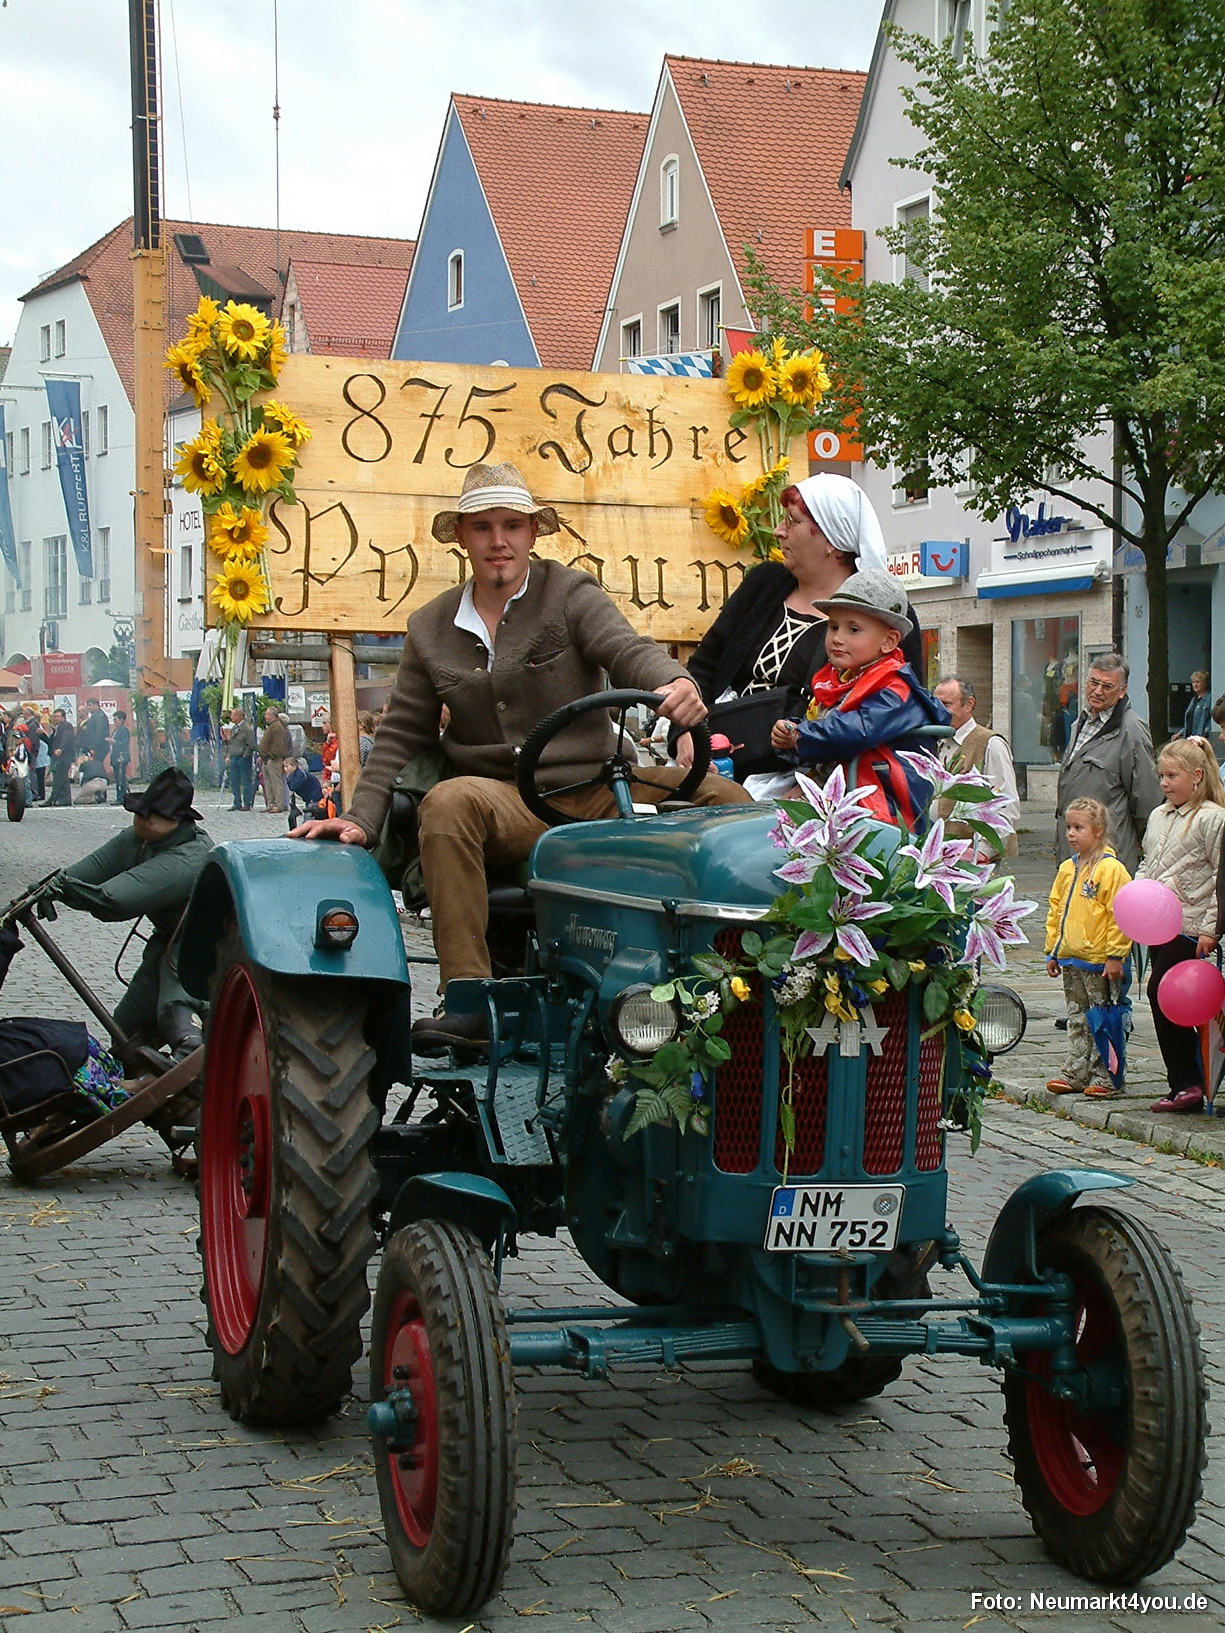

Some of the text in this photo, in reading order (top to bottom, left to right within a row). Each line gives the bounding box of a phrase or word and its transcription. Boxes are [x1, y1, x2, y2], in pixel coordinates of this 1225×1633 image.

[342, 373, 749, 475] 875 Jahre
[180, 510, 201, 531] HOTEL
[778, 1191, 843, 1217] D NM
[774, 1220, 889, 1247] NN 752
